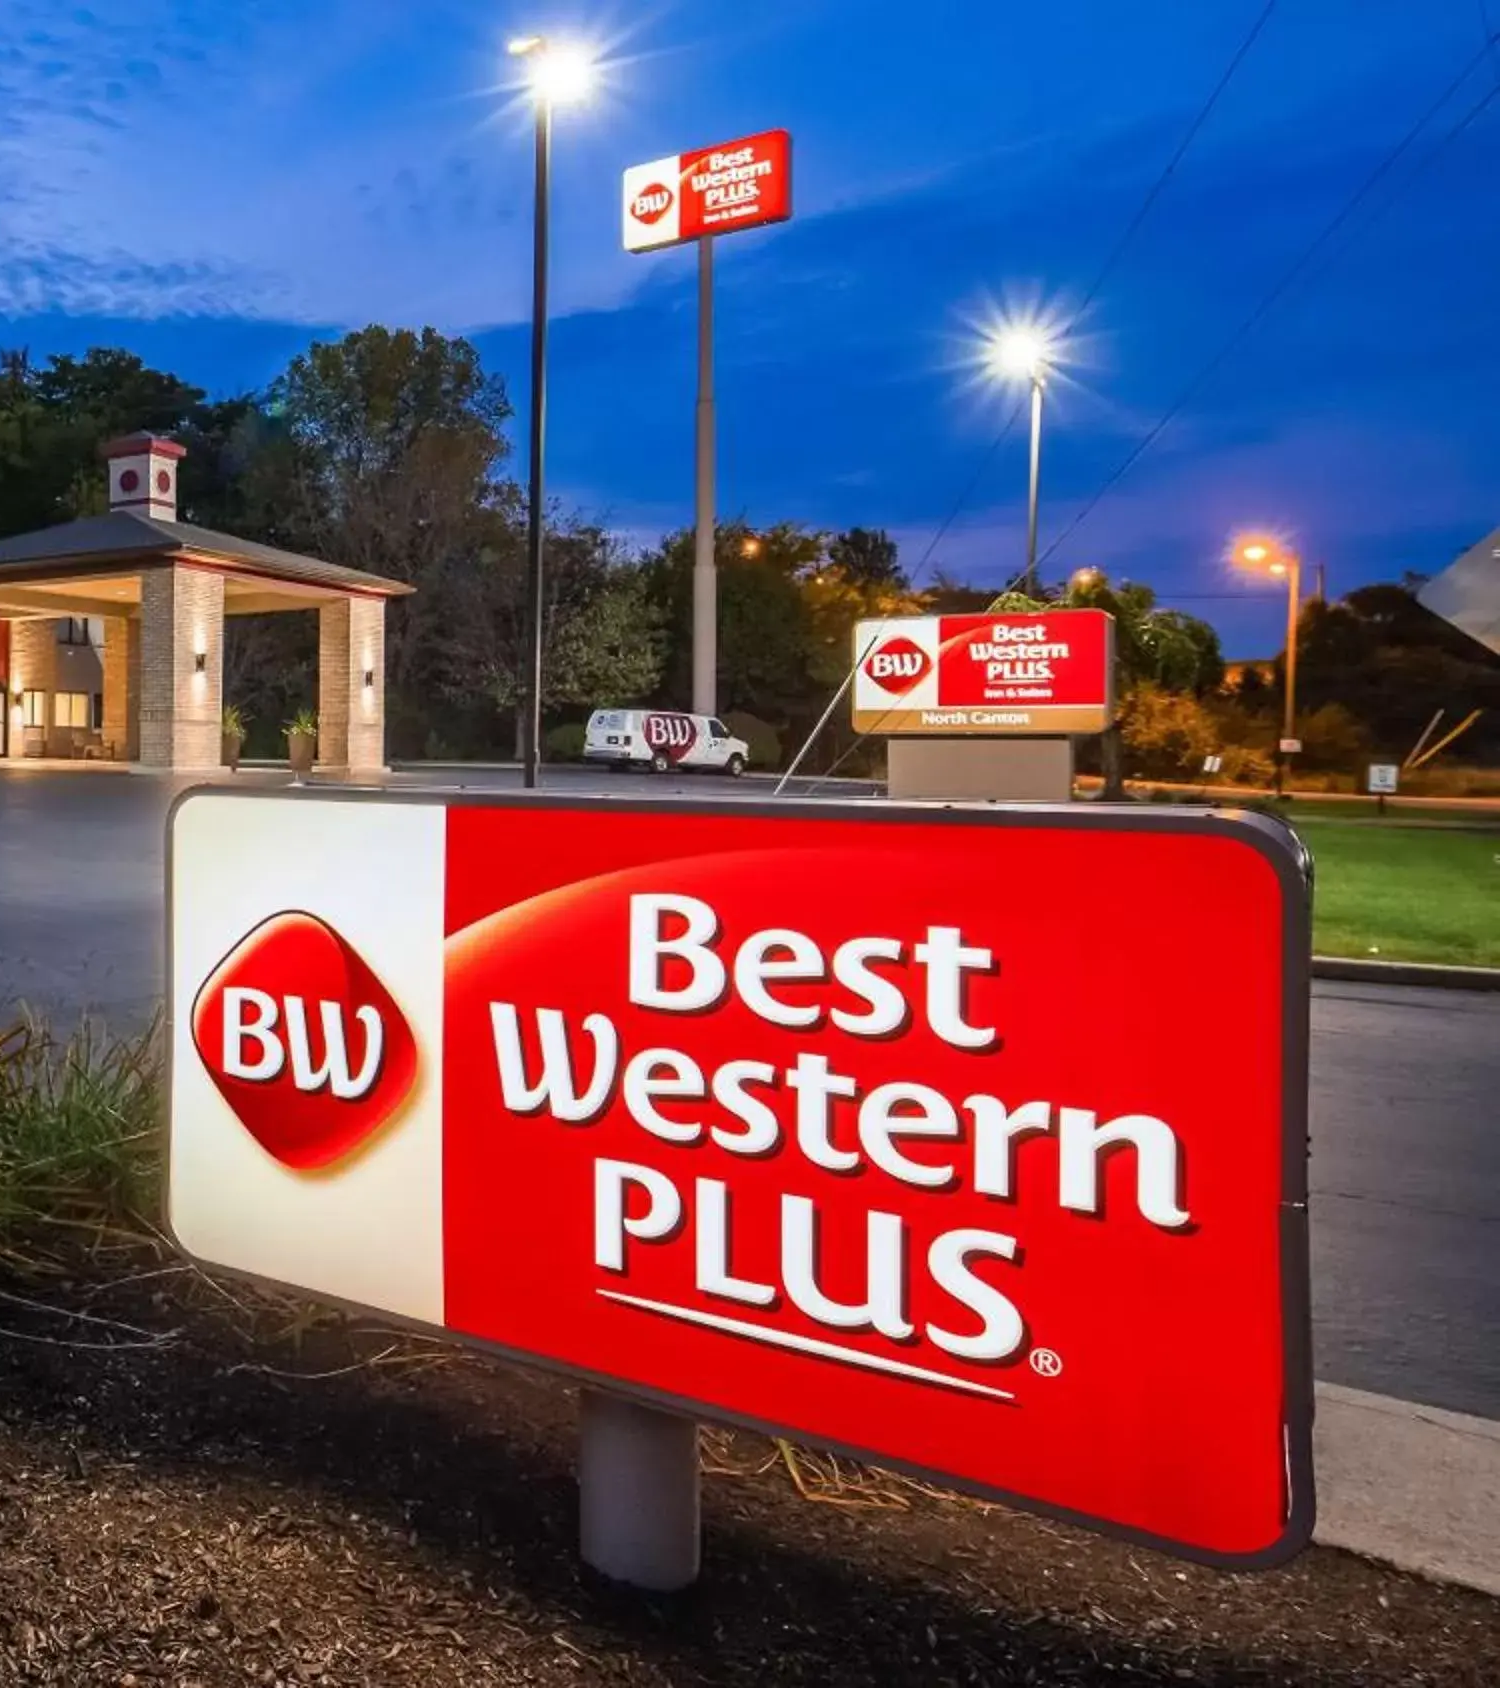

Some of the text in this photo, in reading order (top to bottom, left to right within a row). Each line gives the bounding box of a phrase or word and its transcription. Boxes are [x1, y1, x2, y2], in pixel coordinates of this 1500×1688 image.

[709, 147, 754, 172] Best
[692, 160, 772, 193] Western
[634, 192, 669, 218] BW
[705, 179, 760, 207] PLUS
[993, 624, 1046, 643] Best
[969, 642, 1069, 661] Western
[872, 652, 923, 678] BW
[987, 660, 1055, 680] PLUS
[649, 716, 690, 746] BW
[921, 711, 967, 725] North
[629, 893, 996, 1051] Best
[222, 986, 383, 1100] BW
[490, 1001, 1192, 1230] Western
